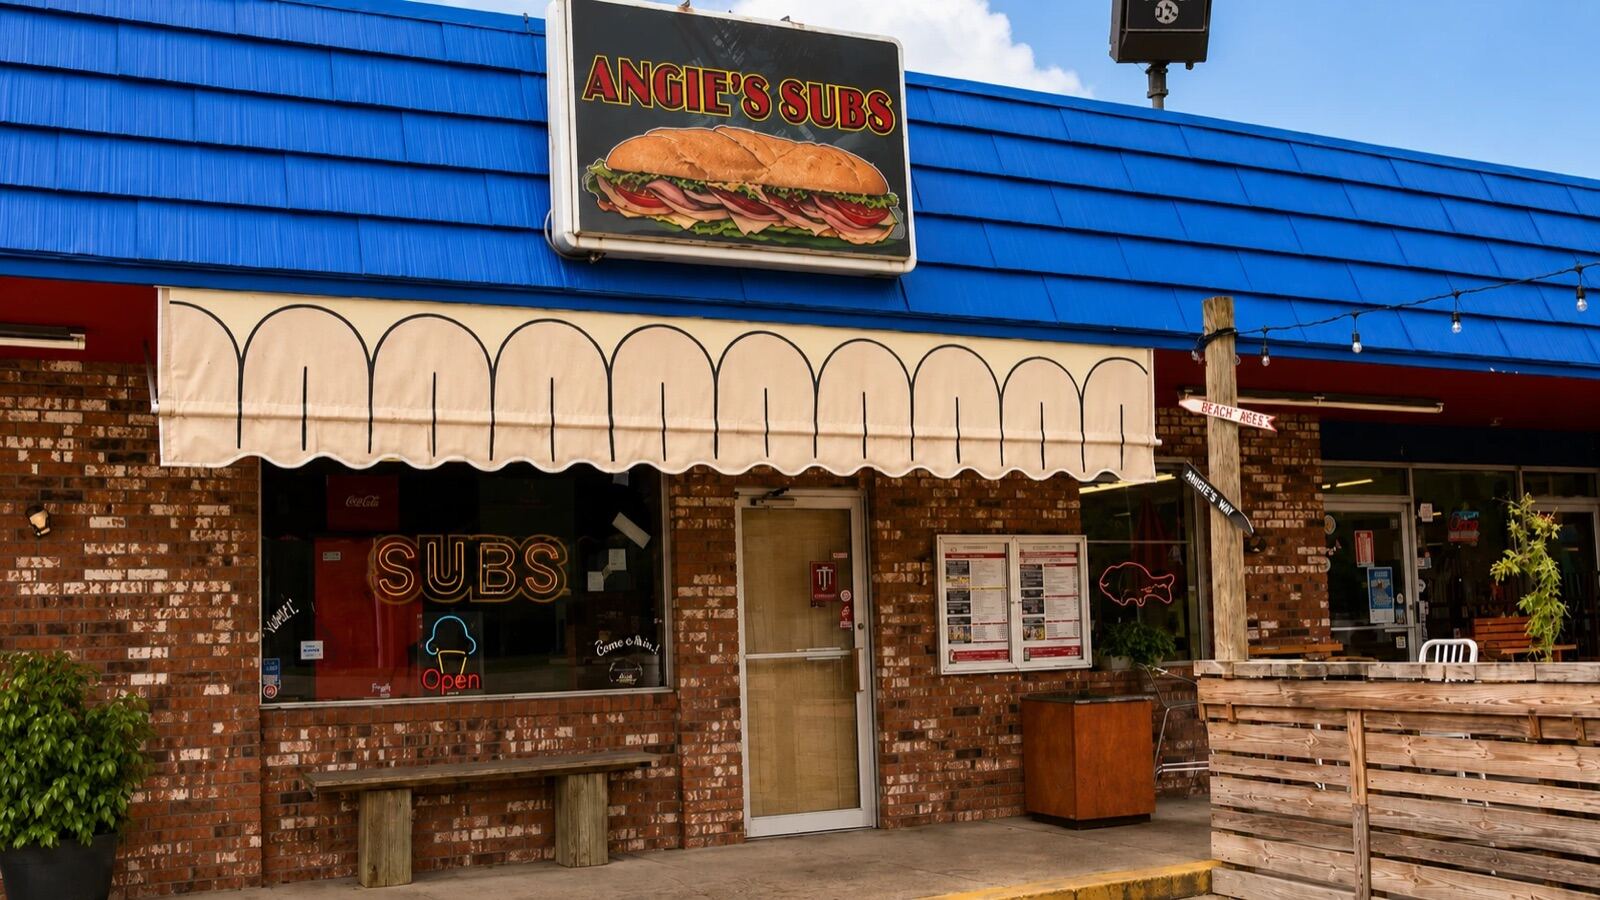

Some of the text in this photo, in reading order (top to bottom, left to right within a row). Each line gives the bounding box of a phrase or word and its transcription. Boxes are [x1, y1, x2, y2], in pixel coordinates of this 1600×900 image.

[582, 55, 896, 136] ANGIE'S SUBS
[1201, 402, 1233, 418] BEACH
[1185, 470, 1235, 517] ANGIE'S WAY
[370, 535, 567, 603] SUBS
[595, 640, 623, 656] Come
[422, 668, 480, 695] Open
